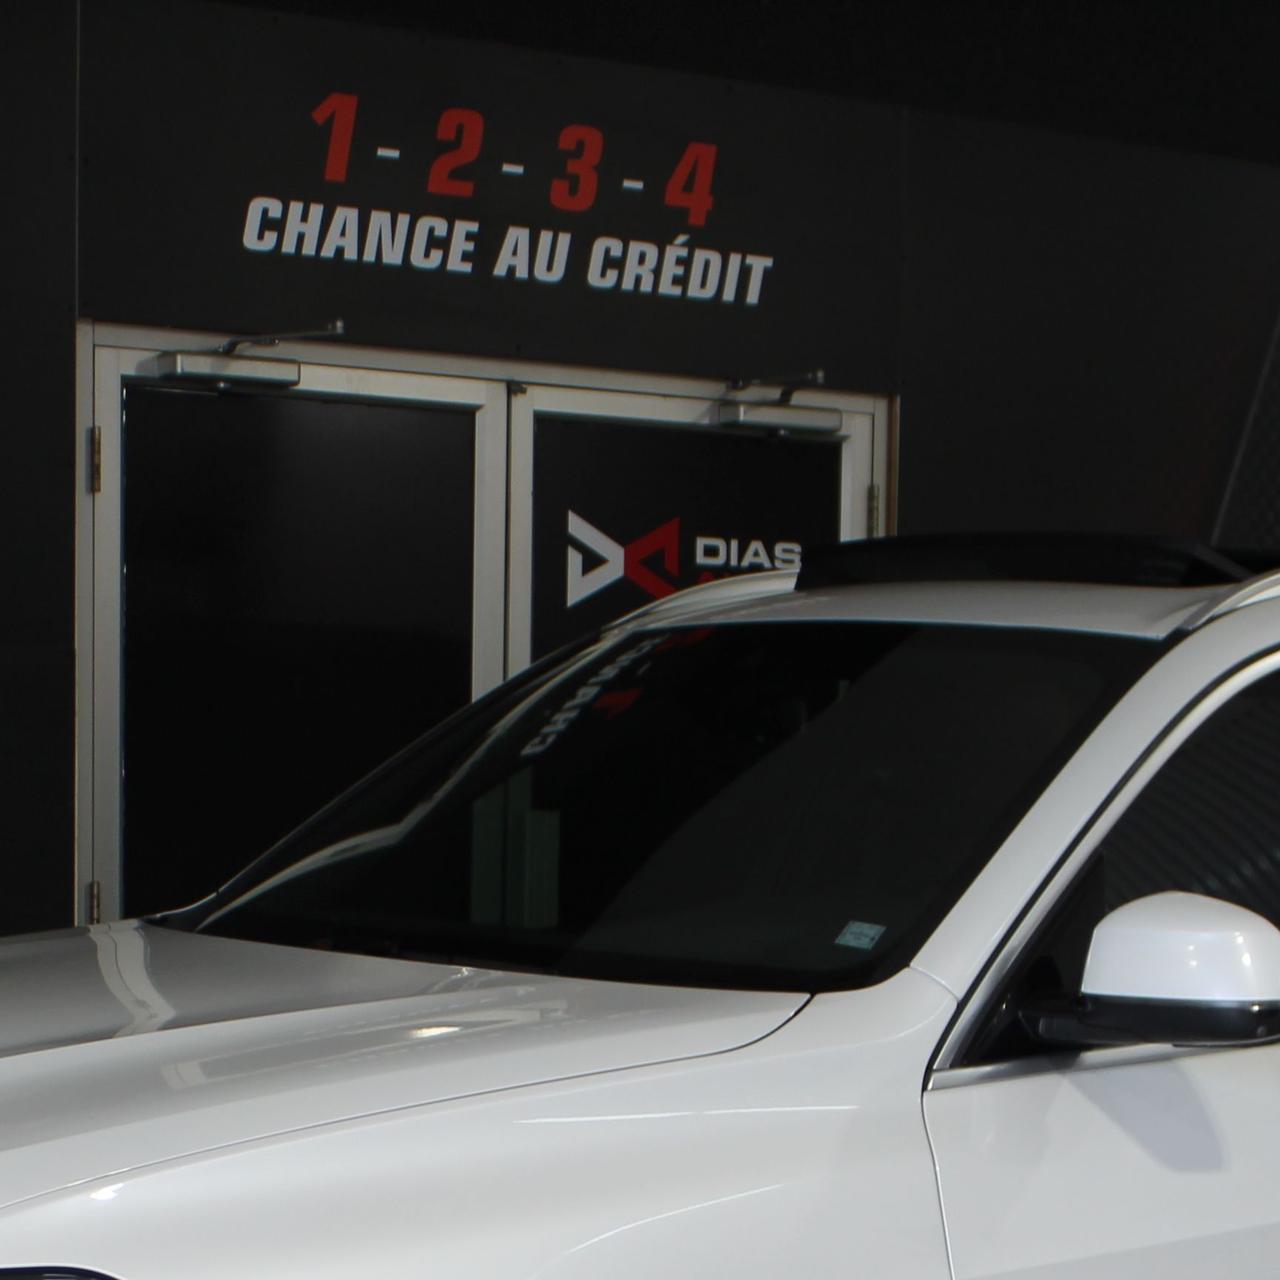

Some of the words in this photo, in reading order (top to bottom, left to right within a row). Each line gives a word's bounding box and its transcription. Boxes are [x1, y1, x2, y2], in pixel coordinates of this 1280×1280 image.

[242, 196, 480, 274] CHANCE
[492, 225, 572, 284] AU
[586, 233, 774, 306] CRÉDIT
[695, 536, 802, 571] DIAS
